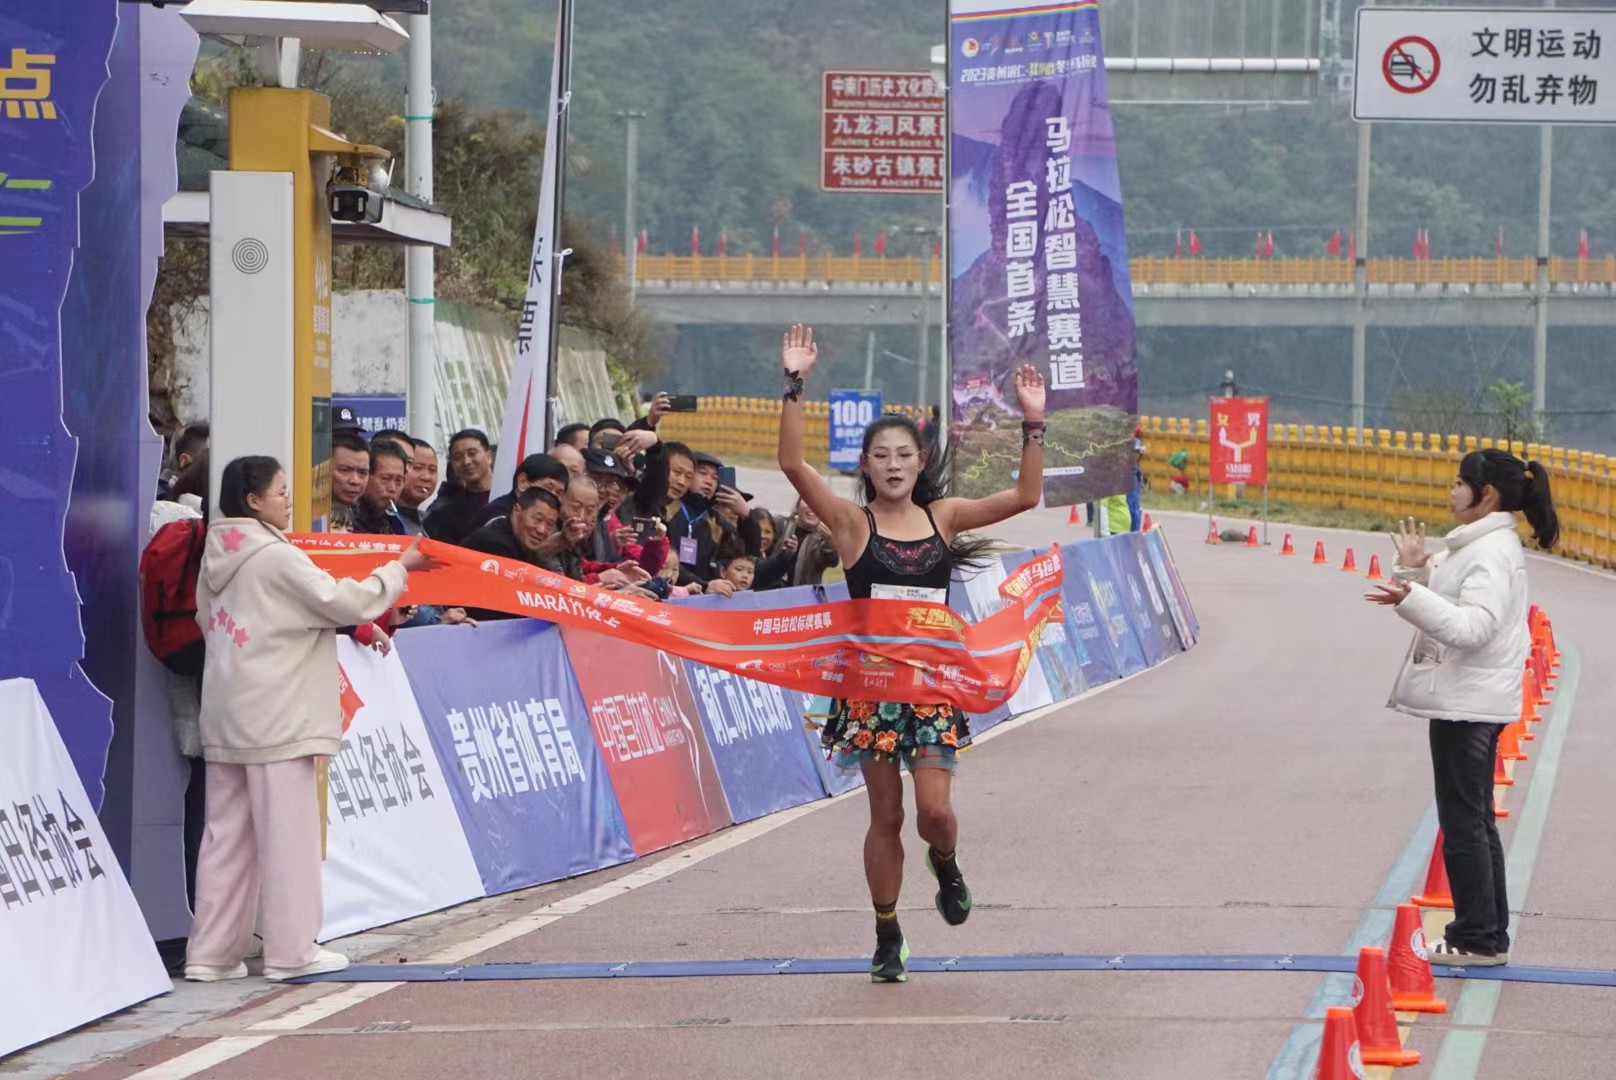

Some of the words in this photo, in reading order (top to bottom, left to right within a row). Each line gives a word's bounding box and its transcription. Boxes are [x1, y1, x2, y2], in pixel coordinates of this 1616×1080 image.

[1471, 27, 1601, 60] 文明运动
[1469, 73, 1598, 105] 勿乱弃物
[1006, 180, 1038, 338] 全国首条
[1044, 116, 1085, 391] 马拉松智慧赛道
[831, 400, 873, 426] 100
[753, 611, 833, 635] 中国马拉松标牌赛事
[446, 698, 586, 803] 贵州省体育局
[592, 691, 665, 763] 中国马拉松
